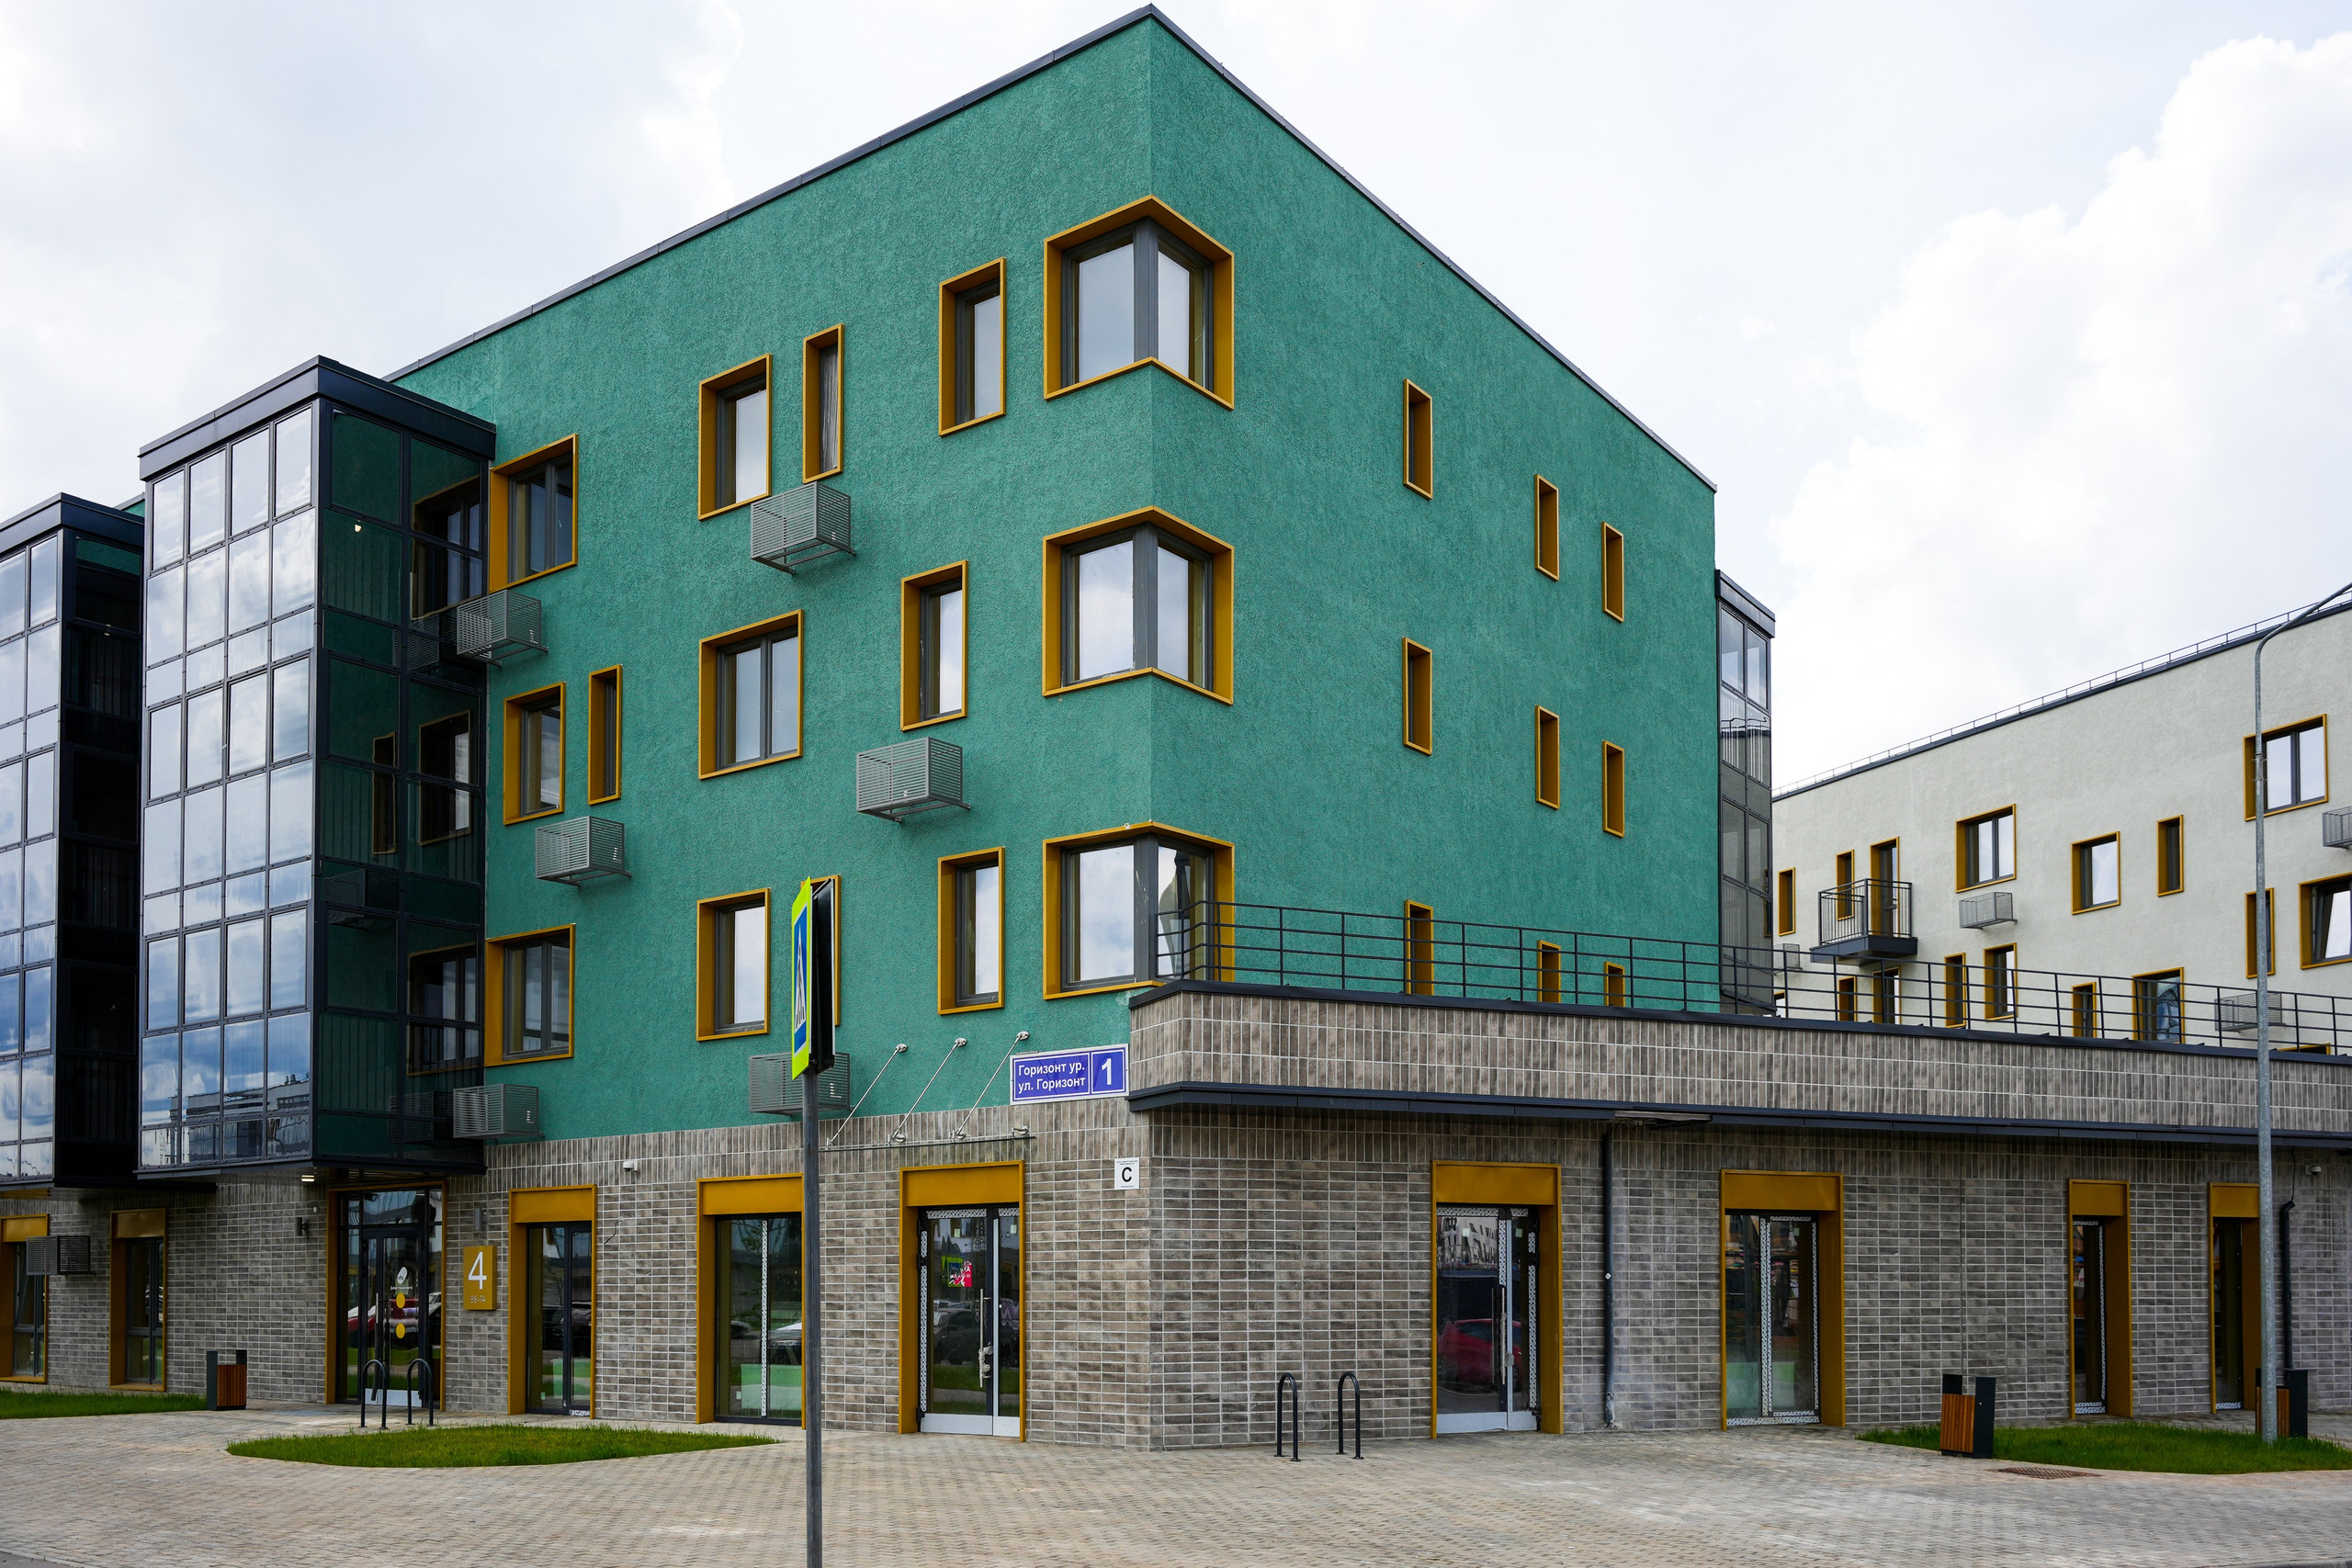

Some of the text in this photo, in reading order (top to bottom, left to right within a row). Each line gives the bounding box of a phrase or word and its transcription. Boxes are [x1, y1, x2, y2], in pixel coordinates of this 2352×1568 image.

[1018, 1062, 1085, 1077] Горизонт ур.
[1102, 1057, 1112, 1086] 1
[1018, 1077, 1086, 1094] ул. Горизонт
[468, 1251, 488, 1290] 4
